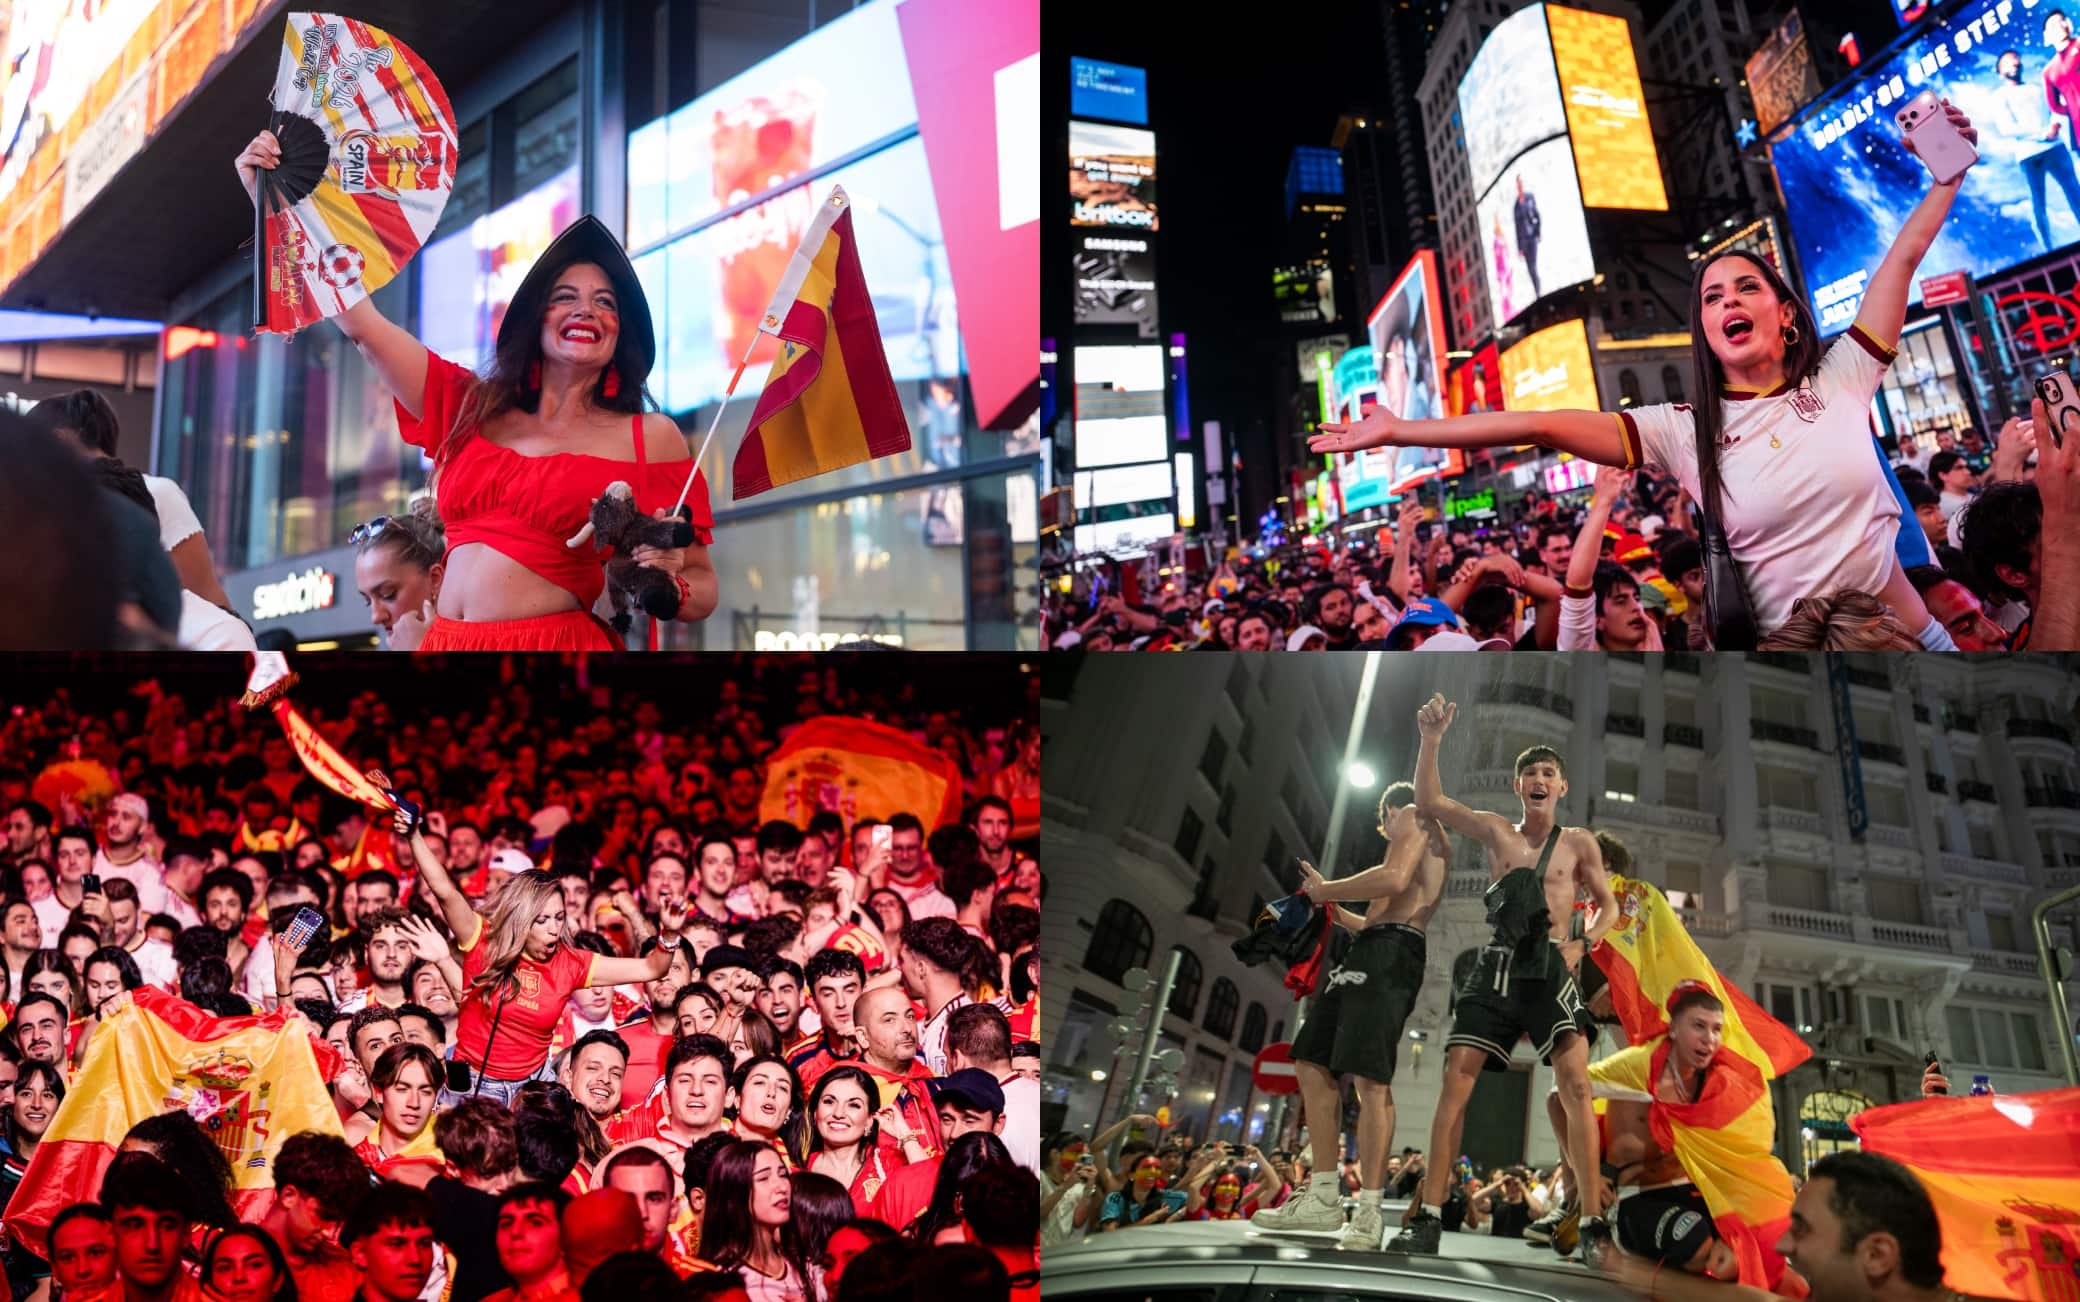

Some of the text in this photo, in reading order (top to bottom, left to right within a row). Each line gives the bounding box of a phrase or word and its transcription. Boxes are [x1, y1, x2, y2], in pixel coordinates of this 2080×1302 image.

[292, 25, 321, 92] World Cup
[363, 46, 394, 74] The
[1813, 95, 1874, 151] BOLDLY
[1906, 43, 1951, 88] ONE
[1953, 0, 2012, 54] STEP
[327, 52, 363, 110] 2026
[346, 143, 365, 186] SPAIN
[1074, 202, 1154, 227] britbox
[1084, 237, 1148, 253] SAMSUNG
[1821, 296, 1858, 329] JULY
[252, 565, 324, 621] swatch
